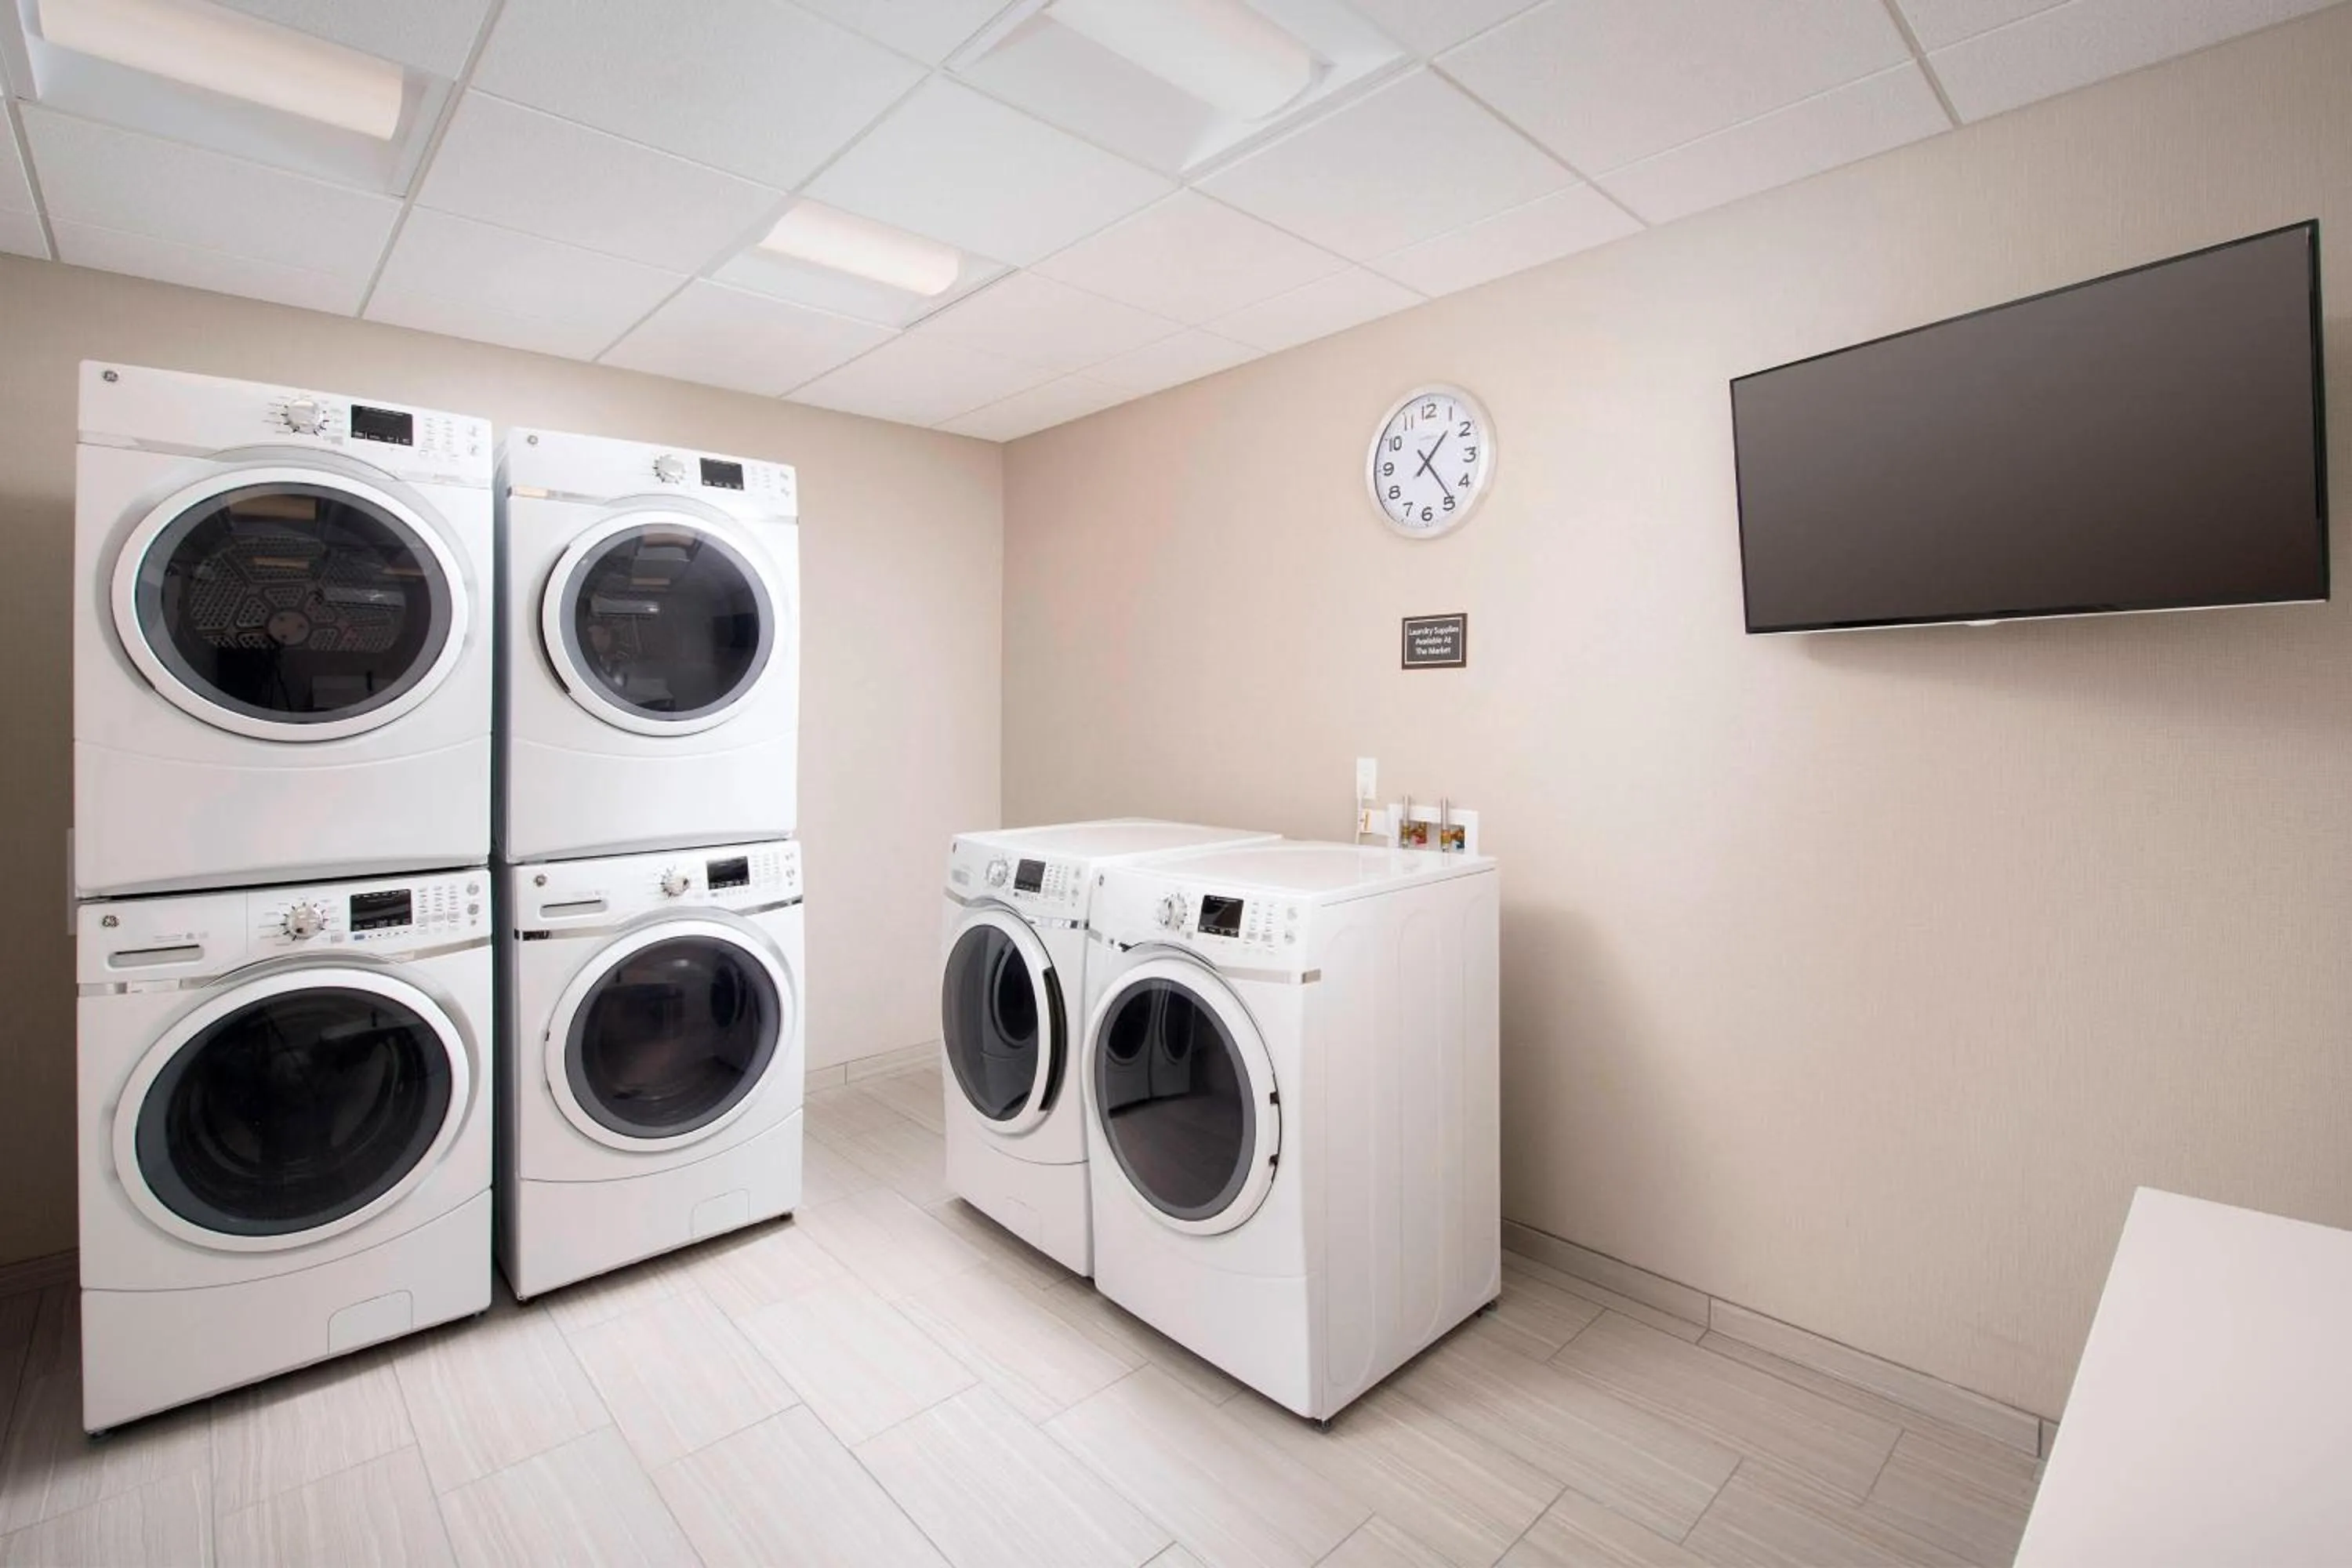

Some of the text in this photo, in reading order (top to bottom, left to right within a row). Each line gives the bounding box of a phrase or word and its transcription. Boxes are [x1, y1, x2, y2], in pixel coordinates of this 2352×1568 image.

[1421, 403, 1437, 419] 12
[1449, 405, 1453, 421] 1
[1404, 414, 1414, 430] 11
[1458, 421, 1472, 437] 2
[1389, 435, 1403, 452] 10
[1463, 446, 1476, 463] 3
[1383, 462, 1395, 476] 9
[1457, 473, 1470, 488] 4
[1388, 485, 1401, 499] 8
[1403, 501, 1414, 517] 7
[1443, 495, 1456, 510] 5
[1421, 506, 1433, 521] 6
[1409, 626, 1433, 636] Laundry
[1428, 646, 1451, 655] Market
